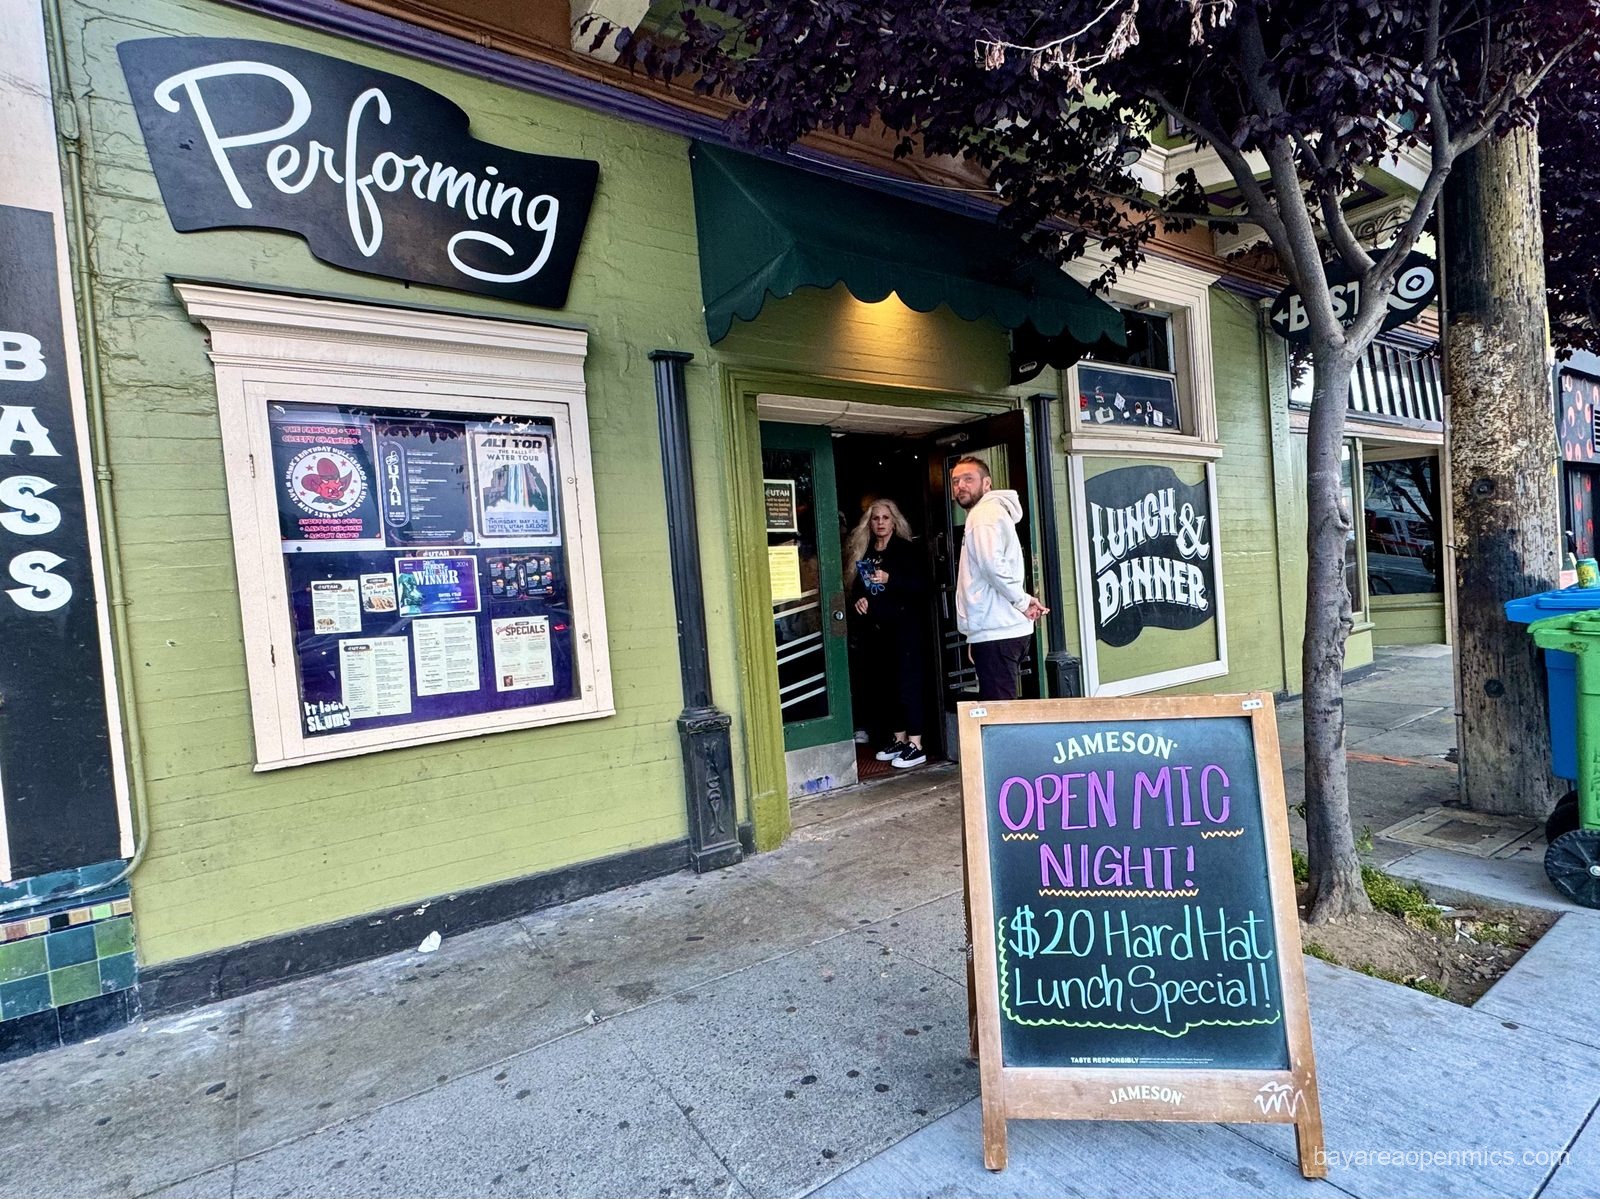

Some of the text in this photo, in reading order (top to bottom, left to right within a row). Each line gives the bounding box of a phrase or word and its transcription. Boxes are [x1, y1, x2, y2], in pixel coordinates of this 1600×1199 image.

[154, 60, 559, 283] Performing
[1289, 266, 1435, 333] BSTO
[298, 446, 332, 459] BIRTHDAY
[302, 426, 338, 434] FAMOUS
[0, 331, 73, 612] BASS
[388, 465, 402, 506] UTAH
[1090, 487, 1211, 573] LUNCH &
[412, 570, 460, 586] WINNER
[1097, 555, 1209, 628] DINNER
[505, 625, 546, 636] SPECIALS
[1053, 731, 1177, 764] JAMESON
[999, 764, 1231, 831] OPEN MIC
[1039, 843, 1195, 890] NIGHT!
[1008, 904, 1273, 962] $20 Hard Hat
[1013, 962, 1272, 1023] Lunch Special!
[1109, 1085, 1184, 1106] JAMESON
